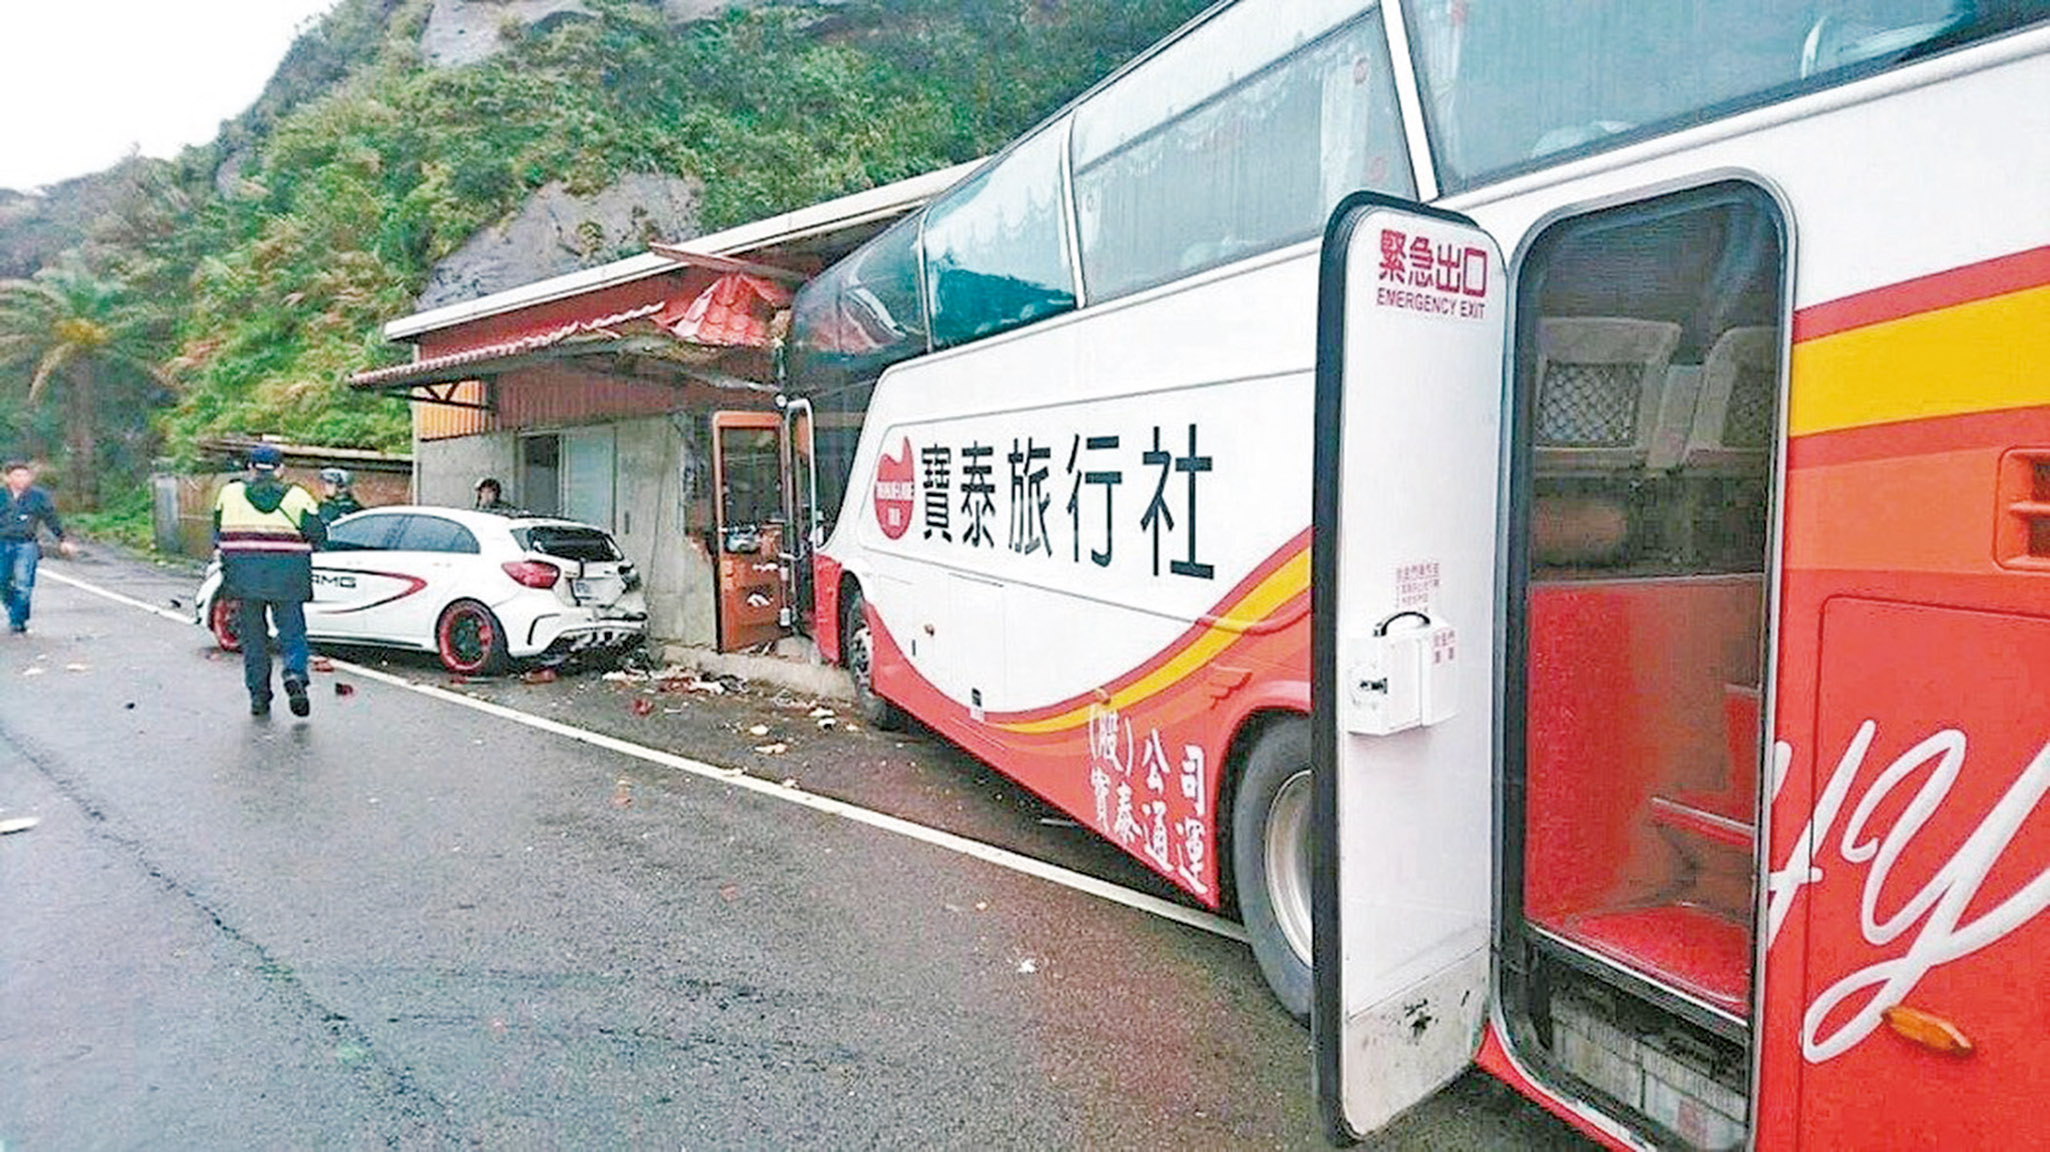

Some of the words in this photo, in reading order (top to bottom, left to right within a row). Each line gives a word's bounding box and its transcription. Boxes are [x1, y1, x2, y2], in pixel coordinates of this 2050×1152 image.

[1379, 229, 1487, 297] 緊急出口
[1377, 287, 1456, 315] EMERGENCY
[1460, 300, 1486, 319] EXIT
[921, 423, 1214, 580] 寶泰旅行社
